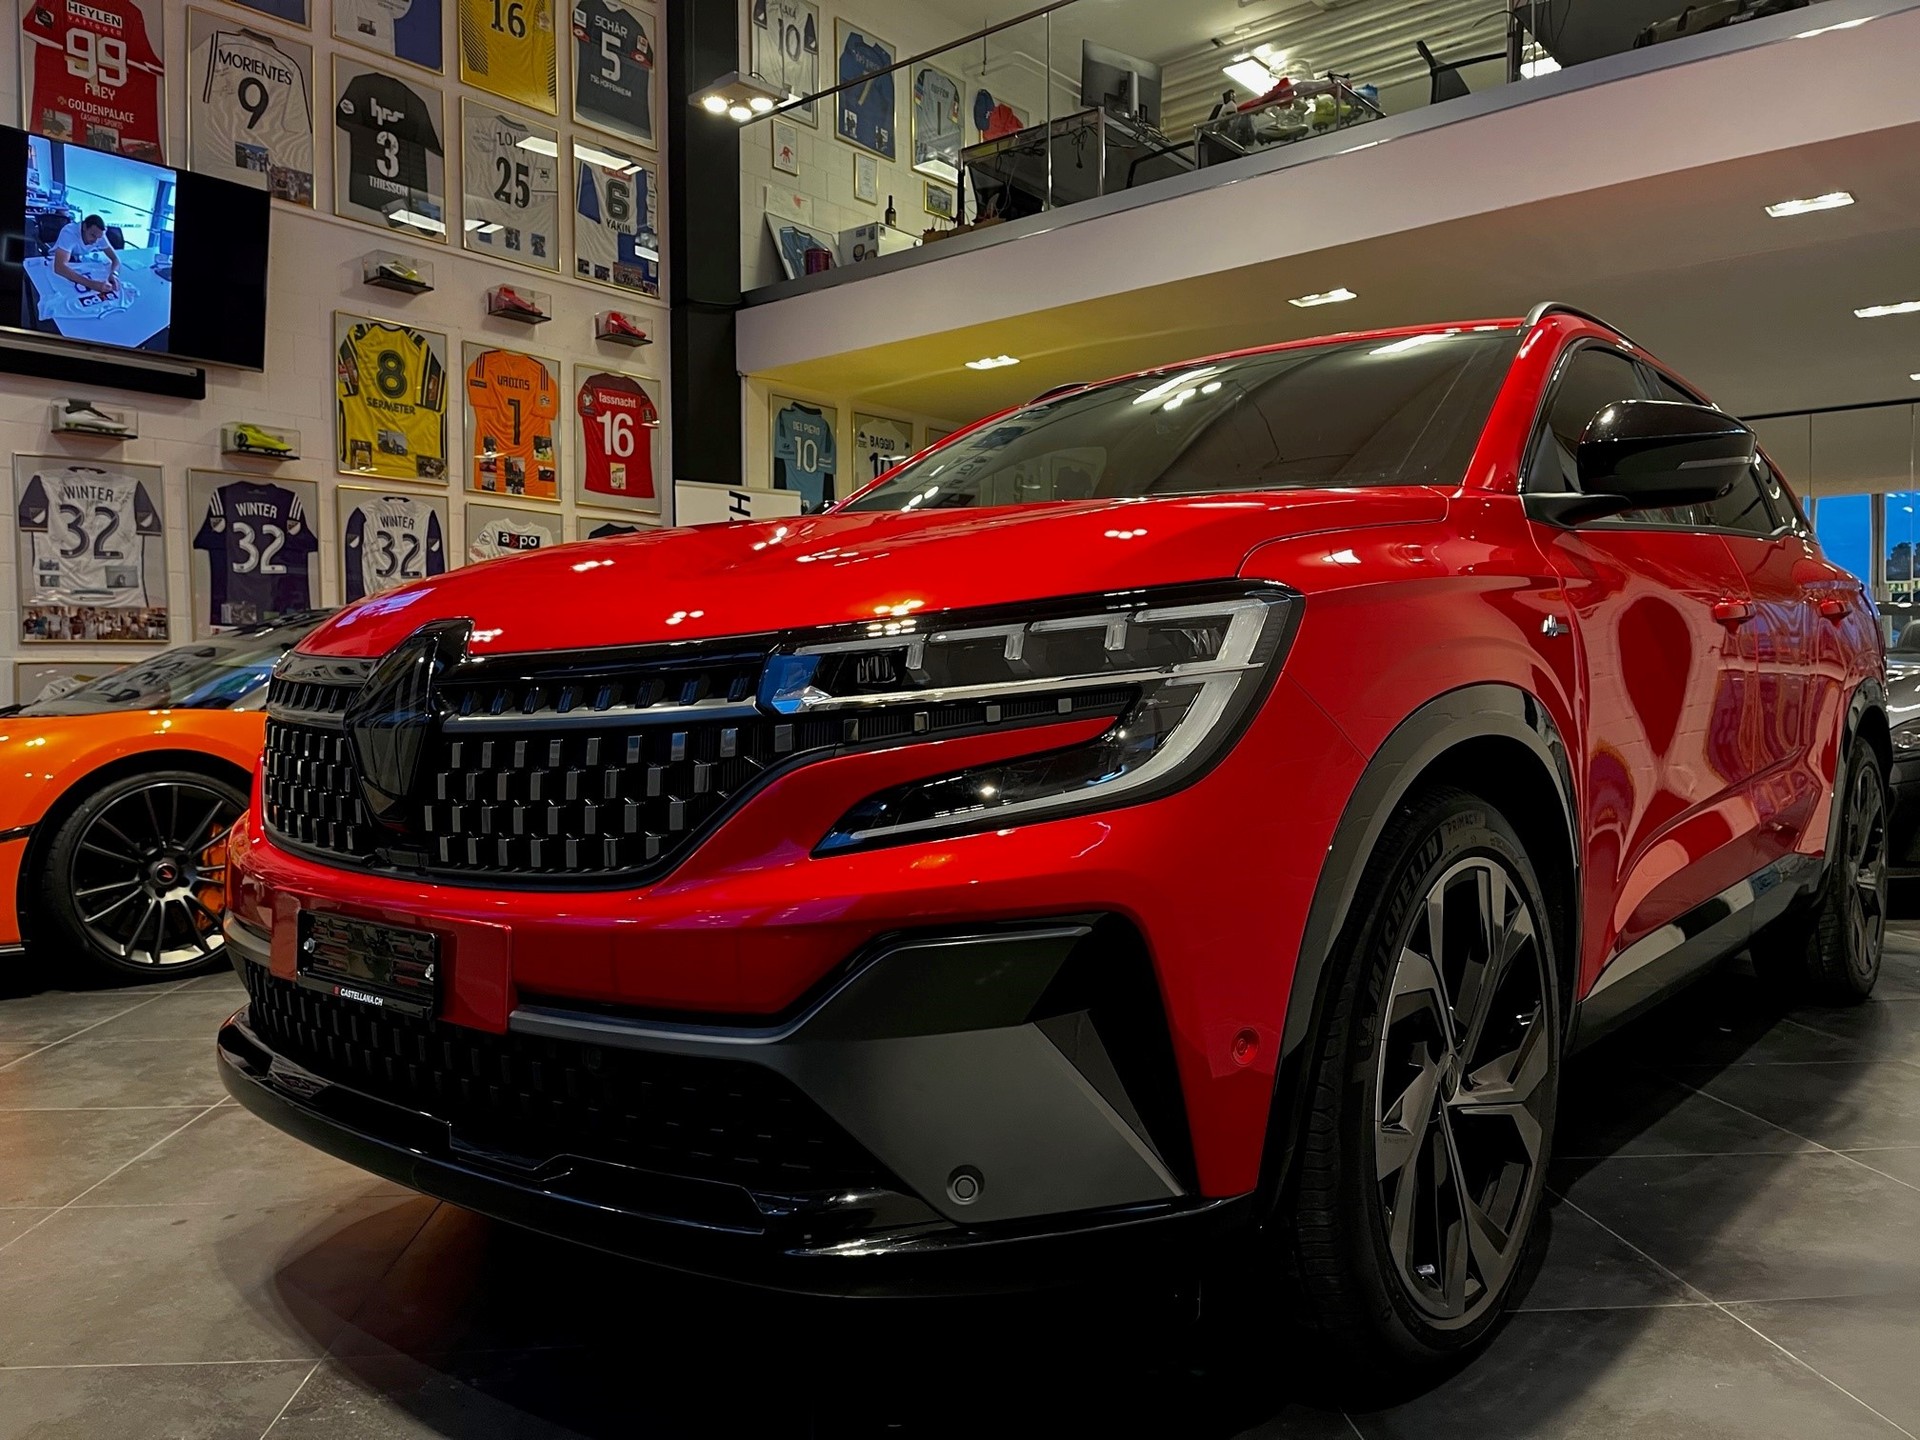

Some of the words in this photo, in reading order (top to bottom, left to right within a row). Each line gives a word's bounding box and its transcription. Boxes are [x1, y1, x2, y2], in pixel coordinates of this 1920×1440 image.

[68, 1, 122, 27] HEYLEN
[490, 0, 526, 38] 16
[66, 27, 127, 87] 99
[601, 31, 621, 82] 5
[778, 18, 801, 62] 10
[218, 48, 292, 86] MORIENTES
[67, 98, 135, 123] GOLDENPALACE
[84, 82, 116, 101] FREY
[238, 77, 269, 129] 9
[376, 131, 399, 178] 3
[494, 156, 530, 209] 25
[606, 178, 630, 223] 6
[606, 218, 631, 234] YAKIN
[377, 349, 408, 399] 8
[599, 392, 637, 409] fassnacht
[507, 398, 520, 445] 1
[597, 410, 635, 458] 16
[795, 436, 818, 473] 10
[869, 435, 895, 451] BAGGIO
[63, 485, 115, 502] WINTER
[235, 502, 278, 519] WINTER
[59, 504, 124, 560] 32
[380, 515, 415, 530] WINTER
[501, 532, 539, 550] axpo
[232, 522, 287, 574] 32
[376, 530, 422, 578] 32
[1367, 833, 1441, 1005] MICHELIN
[340, 988, 384, 1006] CASTELLANA.CH
